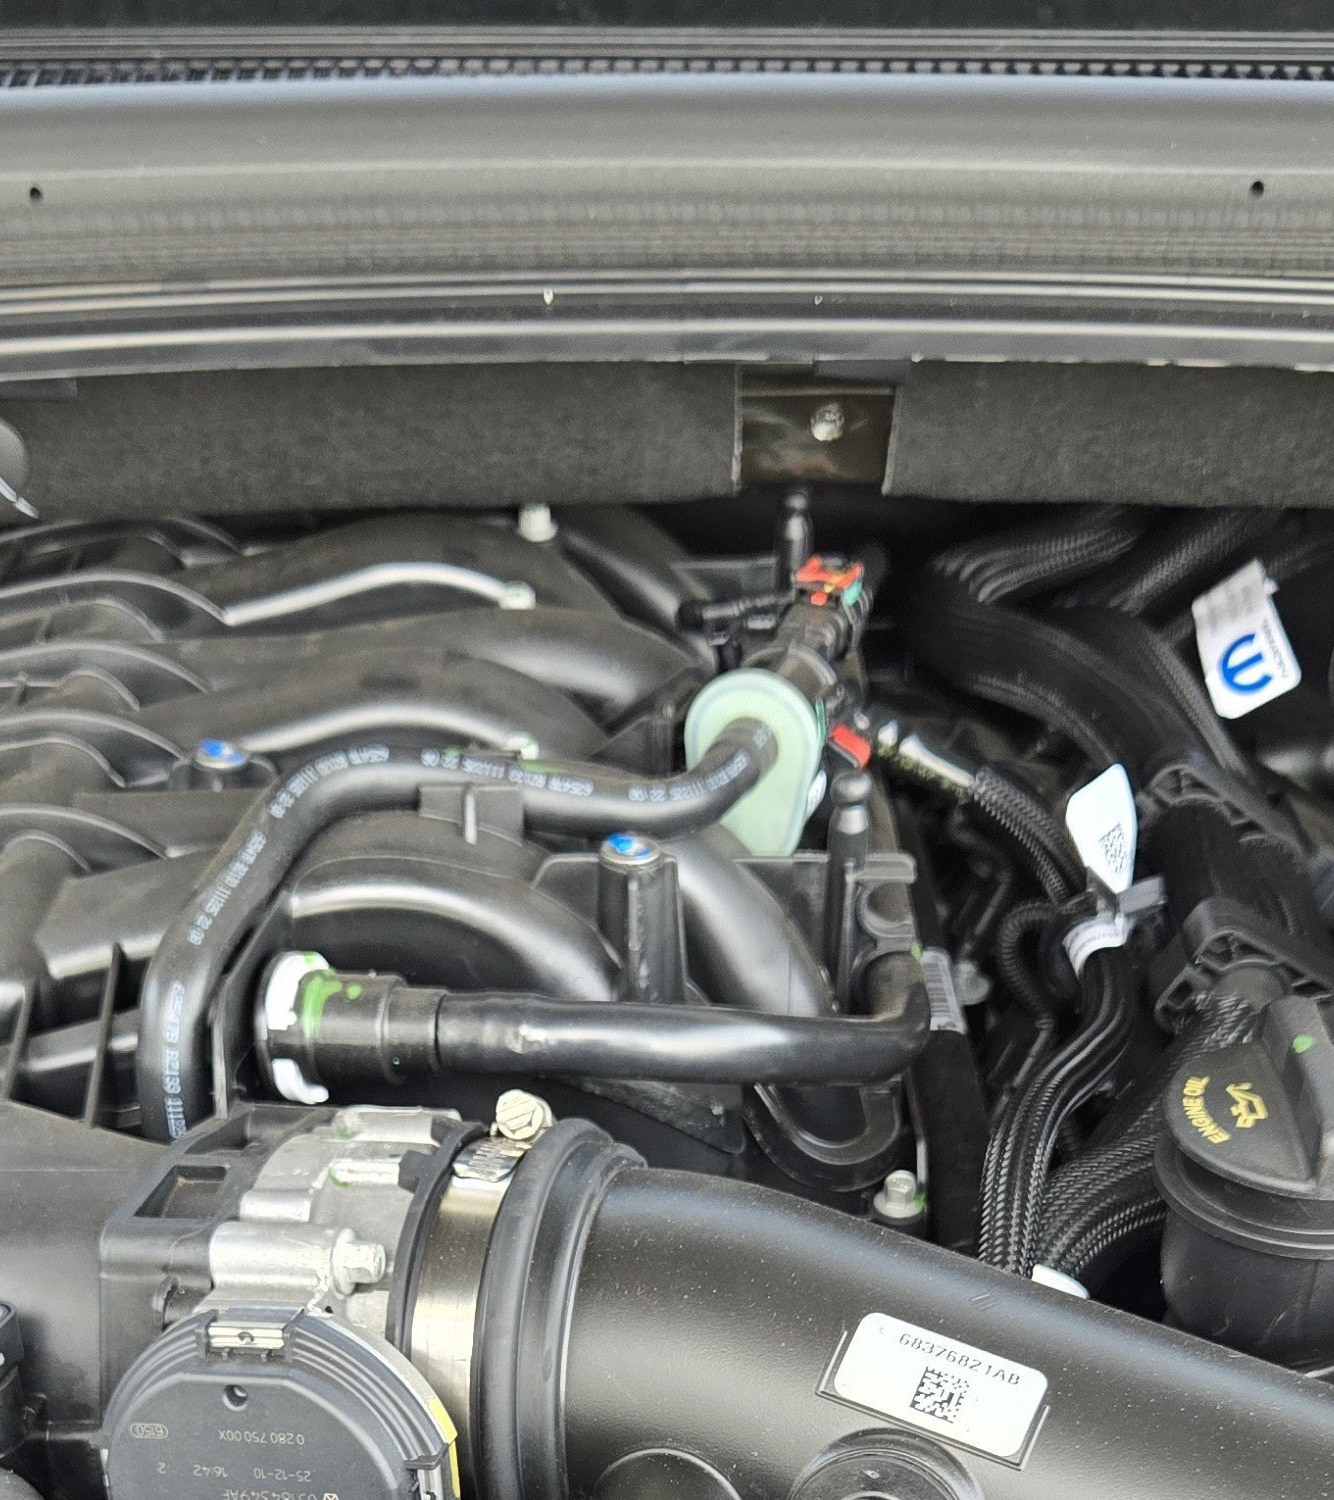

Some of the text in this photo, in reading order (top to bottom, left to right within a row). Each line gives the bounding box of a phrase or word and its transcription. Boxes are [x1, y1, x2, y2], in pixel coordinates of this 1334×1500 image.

[1182, 1076, 1231, 1145] ENGINE OIL
[899, 1333, 1020, 1385] 68376821AB
[157, 1462, 311, 1483] 25-12-10 16:42 2
